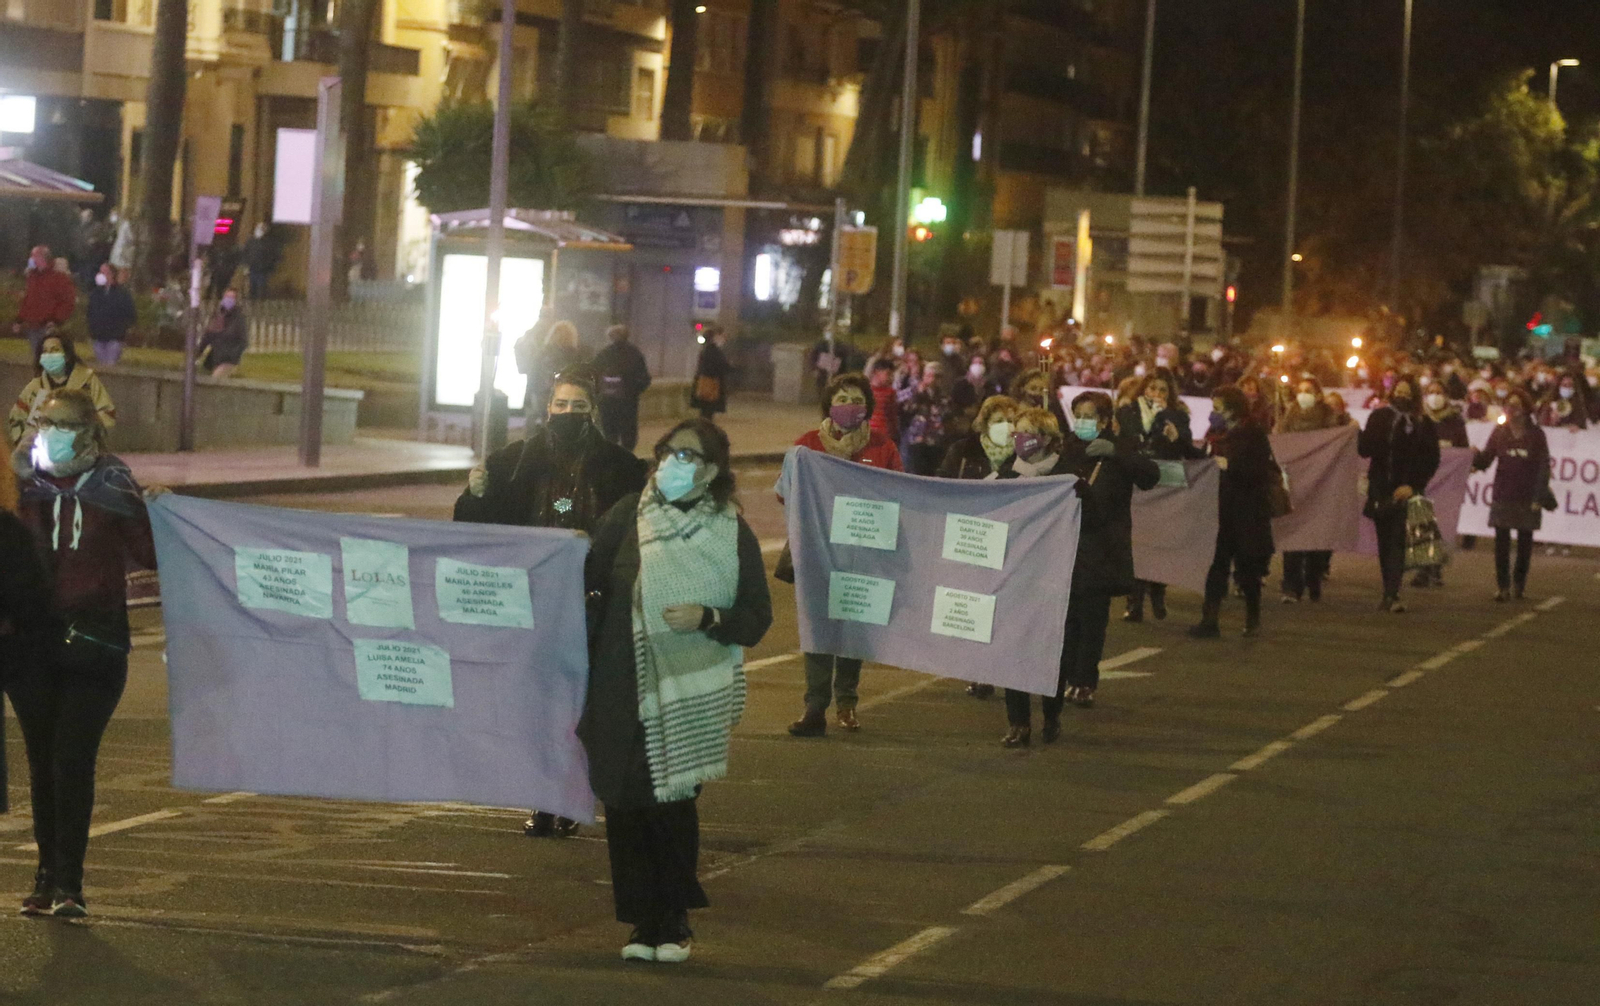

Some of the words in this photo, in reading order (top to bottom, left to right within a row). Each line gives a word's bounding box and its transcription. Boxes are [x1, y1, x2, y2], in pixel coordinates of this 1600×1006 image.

[845, 501, 871, 509] AGOSTO
[871, 503, 884, 511] 2021
[957, 518, 981, 527] AGOSTO
[846, 524, 880, 533] ASESINADA
[968, 535, 983, 543] AÑOS
[956, 540, 988, 552] ASESINADA
[257, 553, 282, 563] JULIO
[284, 555, 302, 564] 2021
[953, 547, 988, 559] BARCELONA
[281, 567, 306, 576] PILAR
[456, 566, 479, 577] JULIO
[481, 570, 499, 578] 2021
[350, 568, 407, 588] LOLAS
[840, 576, 866, 584] AGOSTO
[866, 579, 880, 587] 2021
[258, 583, 306, 597] ASESINADA
[473, 588, 497, 597] AÑOS
[844, 584, 869, 593] CARMEN
[262, 591, 301, 606] NAVARRA
[456, 597, 504, 608] ASESINADA
[945, 591, 968, 600] AGOSTO
[968, 595, 981, 603] 2021
[839, 599, 871, 608] ASESINADA
[944, 614, 975, 625] ASESINADO
[942, 621, 975, 632] BARCELONA
[376, 644, 401, 652] JULIO
[403, 646, 421, 654] 2021
[367, 654, 393, 662] LUISA
[395, 655, 426, 666] AMELIA
[376, 673, 424, 685] ASESINADA
[384, 683, 417, 694] MADRID
